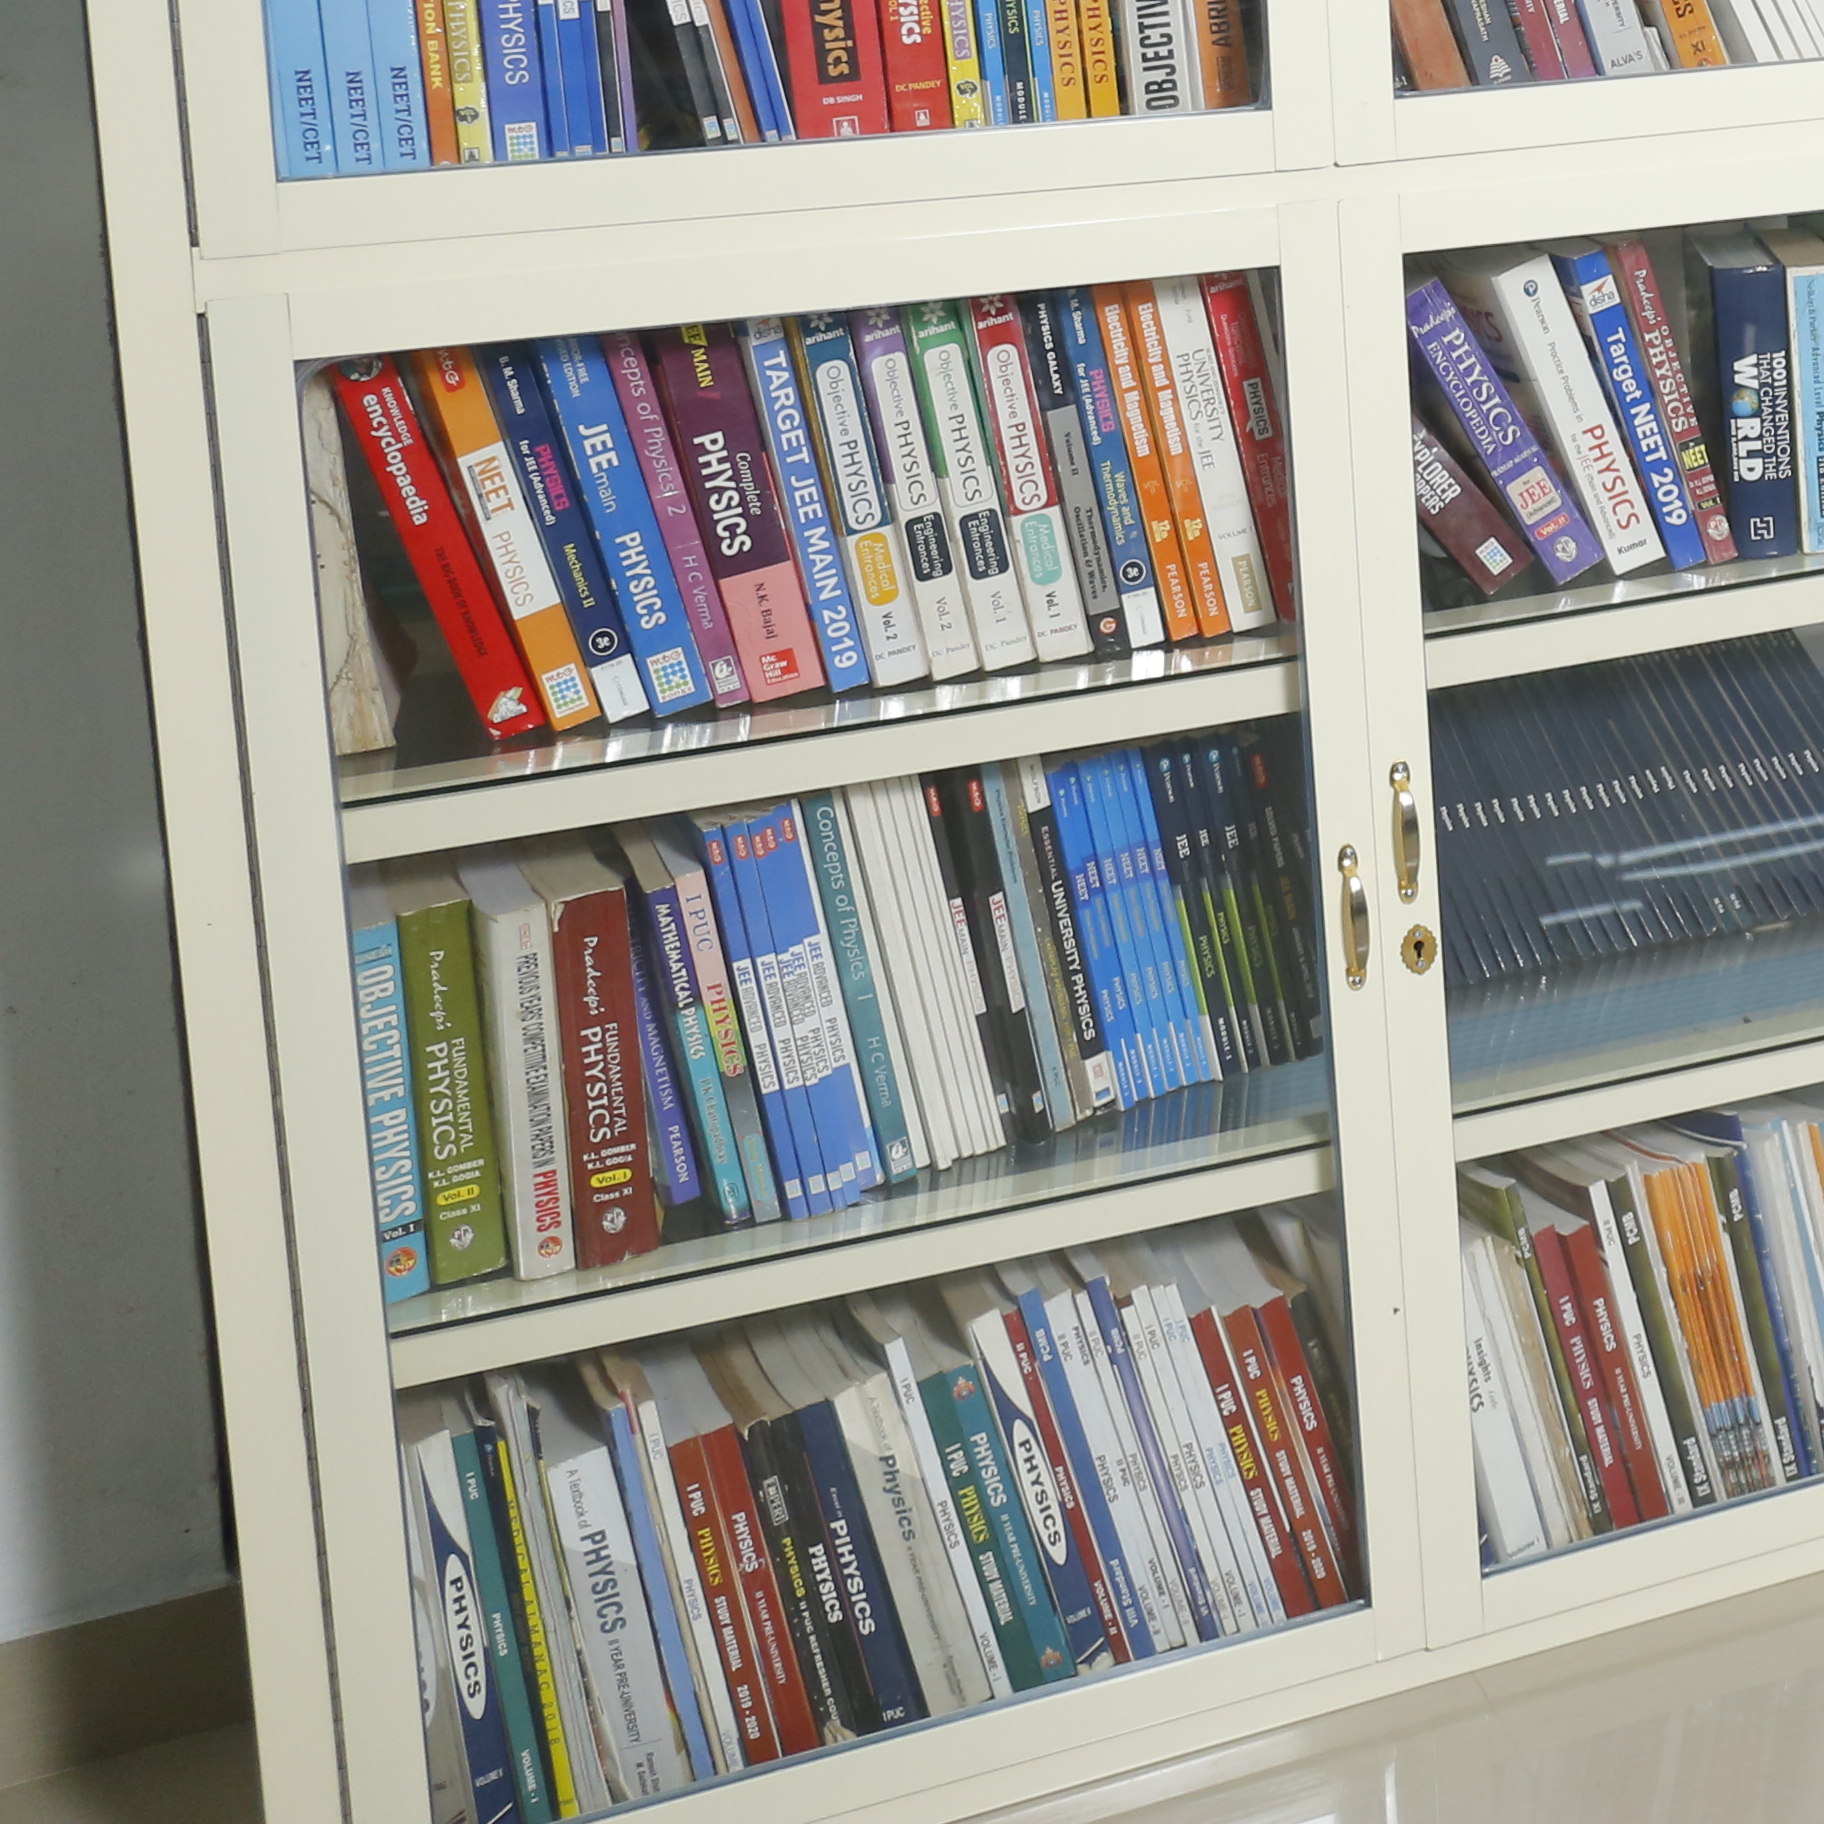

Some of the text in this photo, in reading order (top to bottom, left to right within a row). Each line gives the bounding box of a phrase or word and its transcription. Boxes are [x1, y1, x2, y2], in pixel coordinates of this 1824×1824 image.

[426, 39, 444, 91] BANK
[1610, 49, 1645, 70] ALVA'S
[294, 69, 323, 165] NEET/CET
[380, 386, 414, 447] KNOWLEDGE
[1191, 348, 1226, 443] UNIVERSITY
[1426, 340, 1500, 457] ENCYCLOPEDIA
[1441, 327, 1522, 448] PHYSICS
[1606, 327, 1689, 527] Target NEET 2019
[1758, 353, 1777, 480] THAT CHANGED THE
[1772, 350, 1792, 479] 1001 INVENTIONS
[362, 393, 429, 527] encyclopaedia
[474, 455, 516, 516] NEET
[734, 452, 763, 517] Complete
[826, 364, 876, 526] Objective PHYSICS
[492, 531, 535, 609] PHYSICS
[789, 474, 860, 670] JEE MAIN 2019
[863, 538, 881, 599] Entrances
[871, 543, 894, 590] Medical
[922, 512, 944, 577] Engineering
[1616, 537, 1649, 556] Kumar
[1175, 834, 1191, 860] JEE
[653, 903, 706, 1060] MATHEMATICAL PHYSICS
[1050, 879, 1097, 1042] UNIVERSITY PHYSICS
[357, 965, 418, 1224] OBJECTIVE PHYSICS
[426, 1043, 457, 1161] PHYSICS
[451, 1037, 473, 1153] FUNDAMENTAL
[969, 1432, 1008, 1508] PHYSICS
[731, 1512, 759, 1573] PHYSICS
[448, 1575, 483, 1701] PHYSICS
